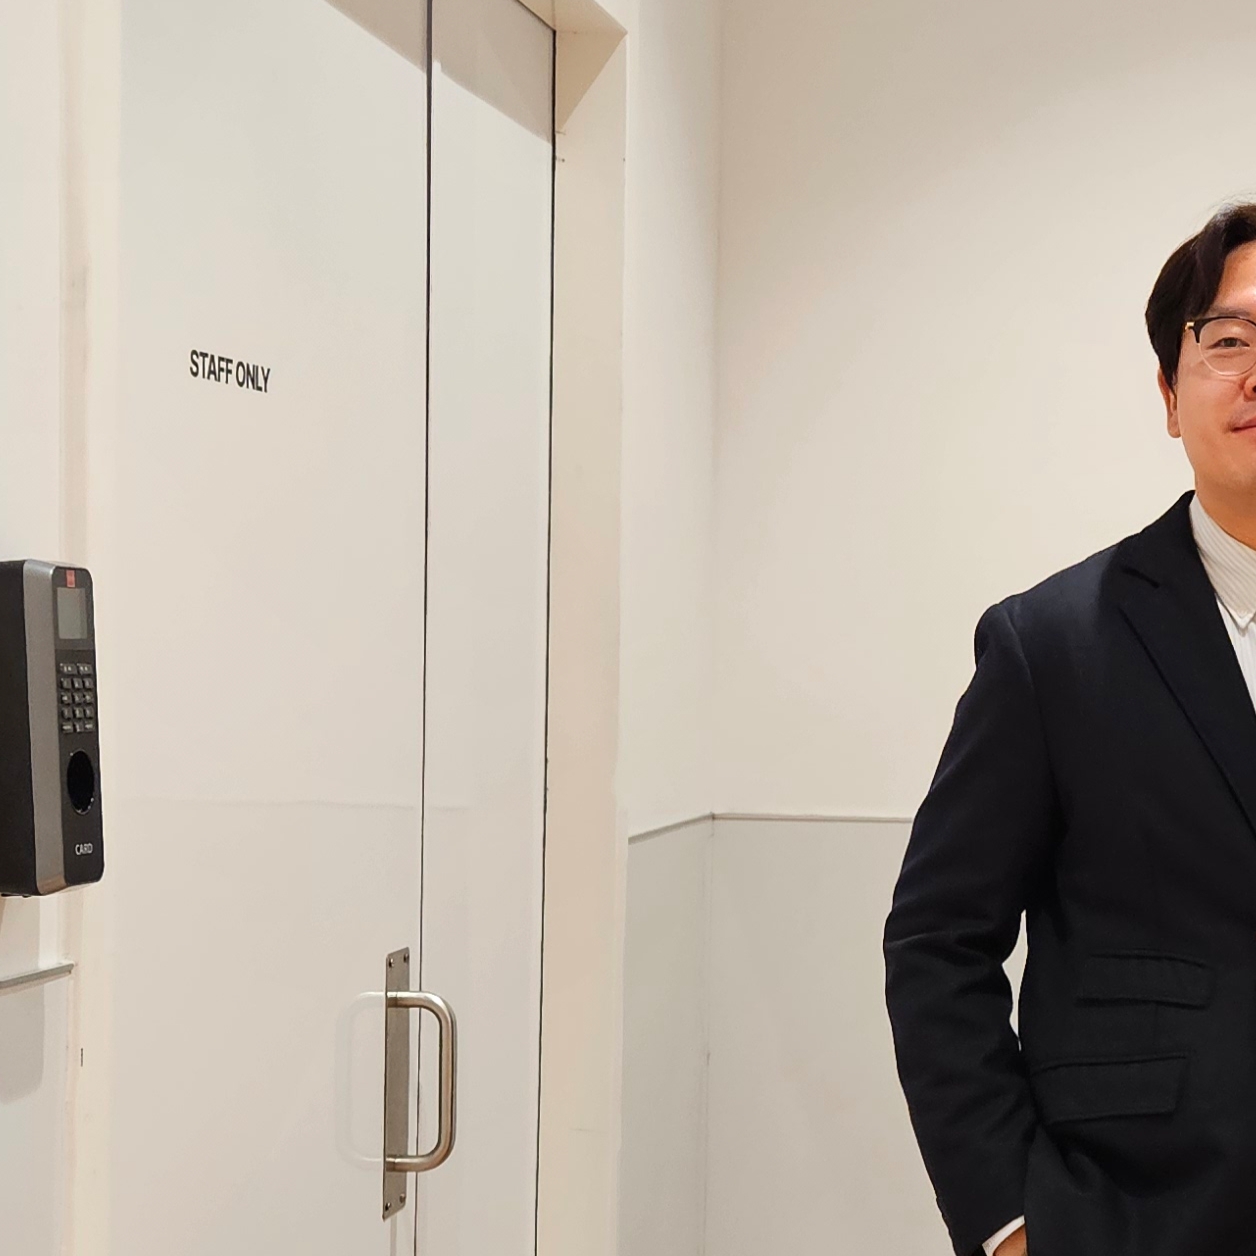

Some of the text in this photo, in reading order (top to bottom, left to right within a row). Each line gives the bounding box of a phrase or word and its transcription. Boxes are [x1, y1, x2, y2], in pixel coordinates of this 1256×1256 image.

[189, 349, 271, 393] STAFF ONLY
[75, 842, 94, 856] CARD
